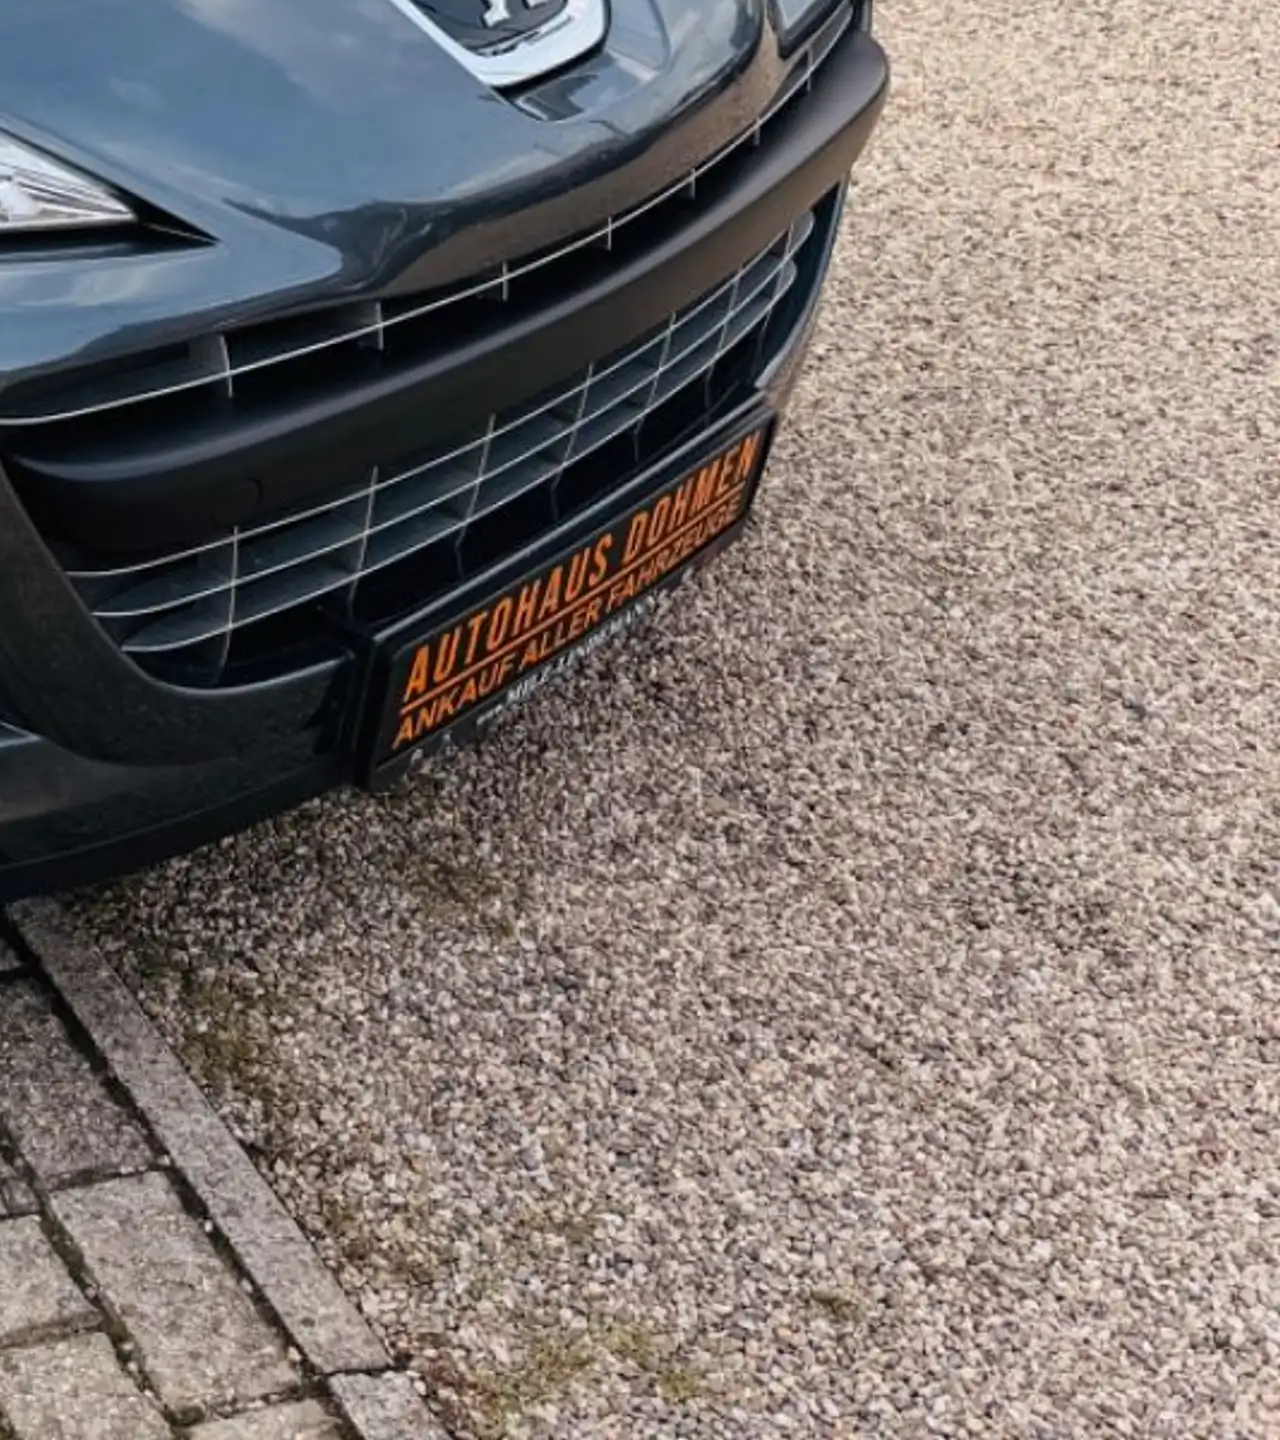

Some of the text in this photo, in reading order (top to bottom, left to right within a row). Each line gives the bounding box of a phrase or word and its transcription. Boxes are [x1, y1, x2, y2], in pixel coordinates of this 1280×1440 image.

[392, 653, 517, 750] ANKAUF
[517, 598, 602, 672] ALLER
[607, 494, 742, 612] FAHRZEUGE
[403, 533, 613, 703] AUTOHAUS
[622, 430, 762, 565] DOHMEN
